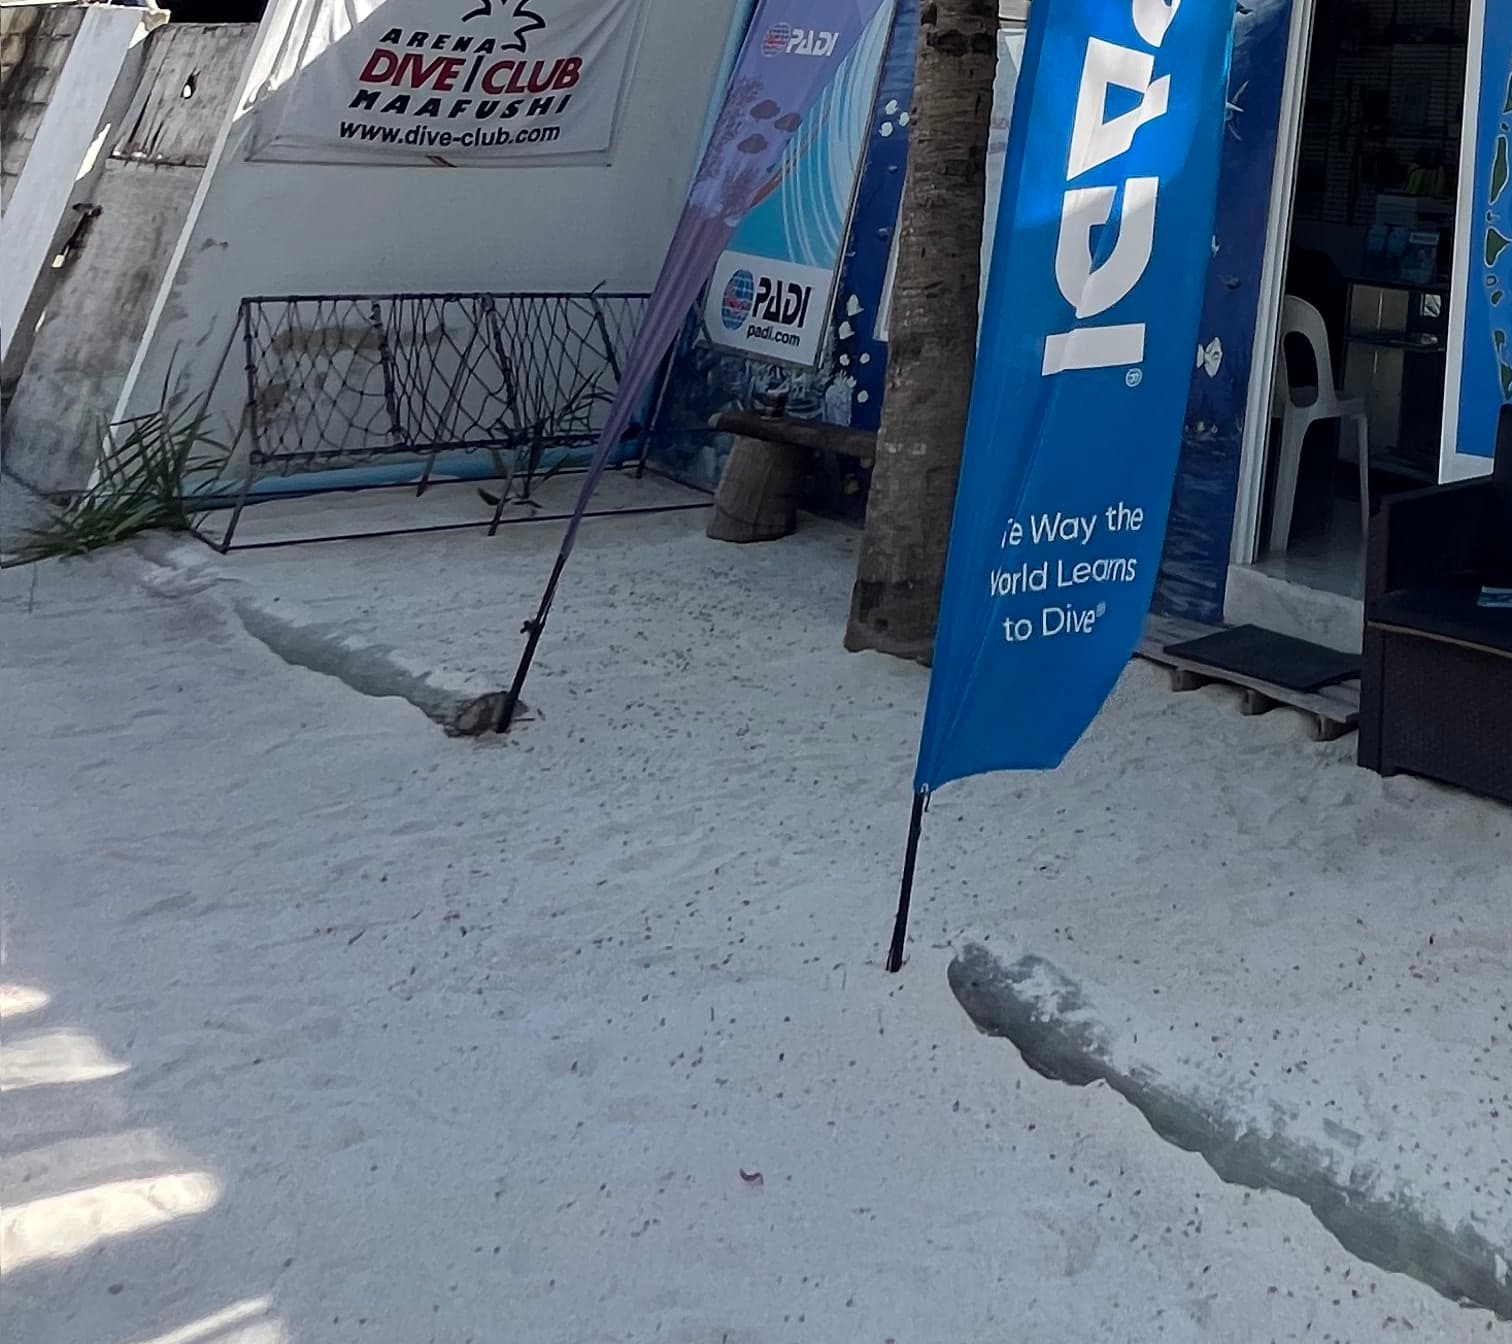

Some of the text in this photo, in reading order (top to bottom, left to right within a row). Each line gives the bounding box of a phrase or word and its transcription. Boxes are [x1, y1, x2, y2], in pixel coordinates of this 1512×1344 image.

[379, 27, 497, 55] ARENA
[785, 27, 840, 58] PADI
[358, 47, 584, 96] DIVE CLUB
[348, 88, 572, 121] MAAFUSHI
[339, 120, 561, 148] www.dive-club.com
[751, 276, 813, 329] PADI
[745, 324, 801, 348] padi.com
[1030, 511, 1098, 546] Way
[1104, 500, 1145, 532] the
[1002, 615, 1033, 642] to
